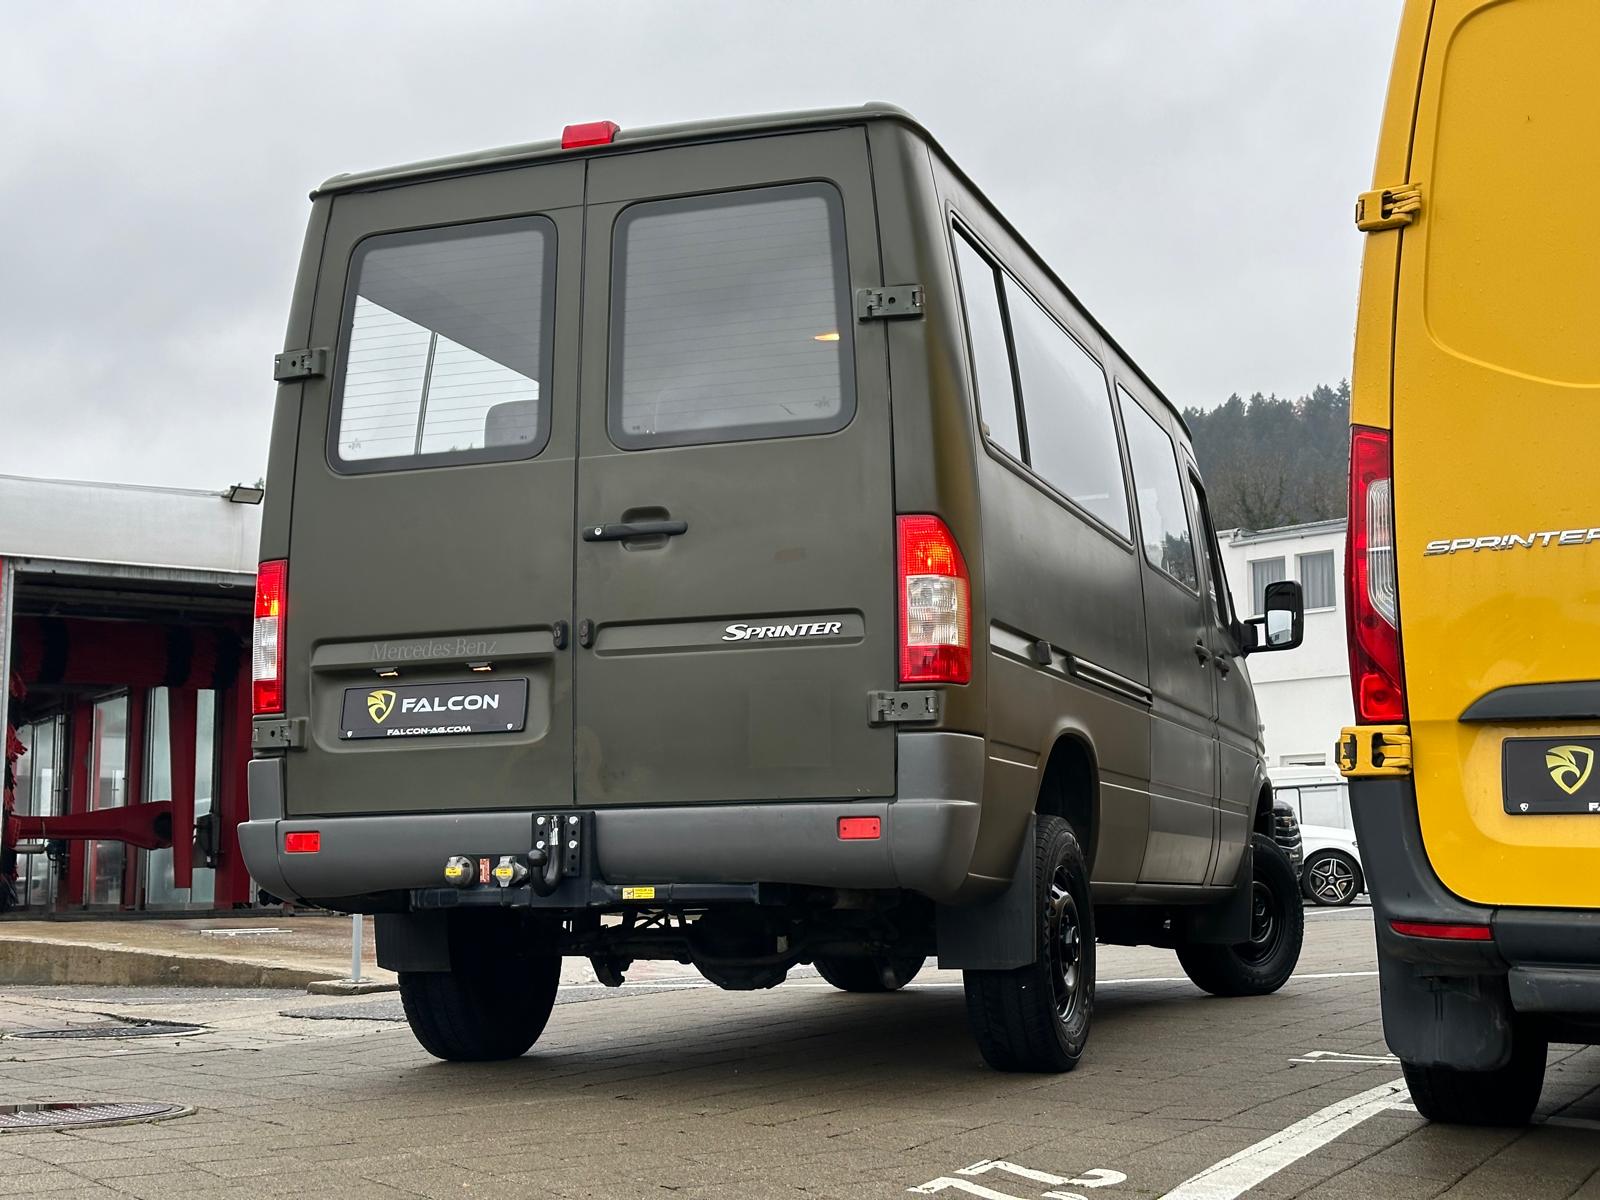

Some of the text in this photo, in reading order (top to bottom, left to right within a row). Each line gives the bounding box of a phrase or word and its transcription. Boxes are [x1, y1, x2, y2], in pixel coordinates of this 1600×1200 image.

[370, 638, 498, 661] Mercedes-Benz
[401, 694, 500, 713] FALCON
[386, 725, 472, 736] FALCON-AG.COM
